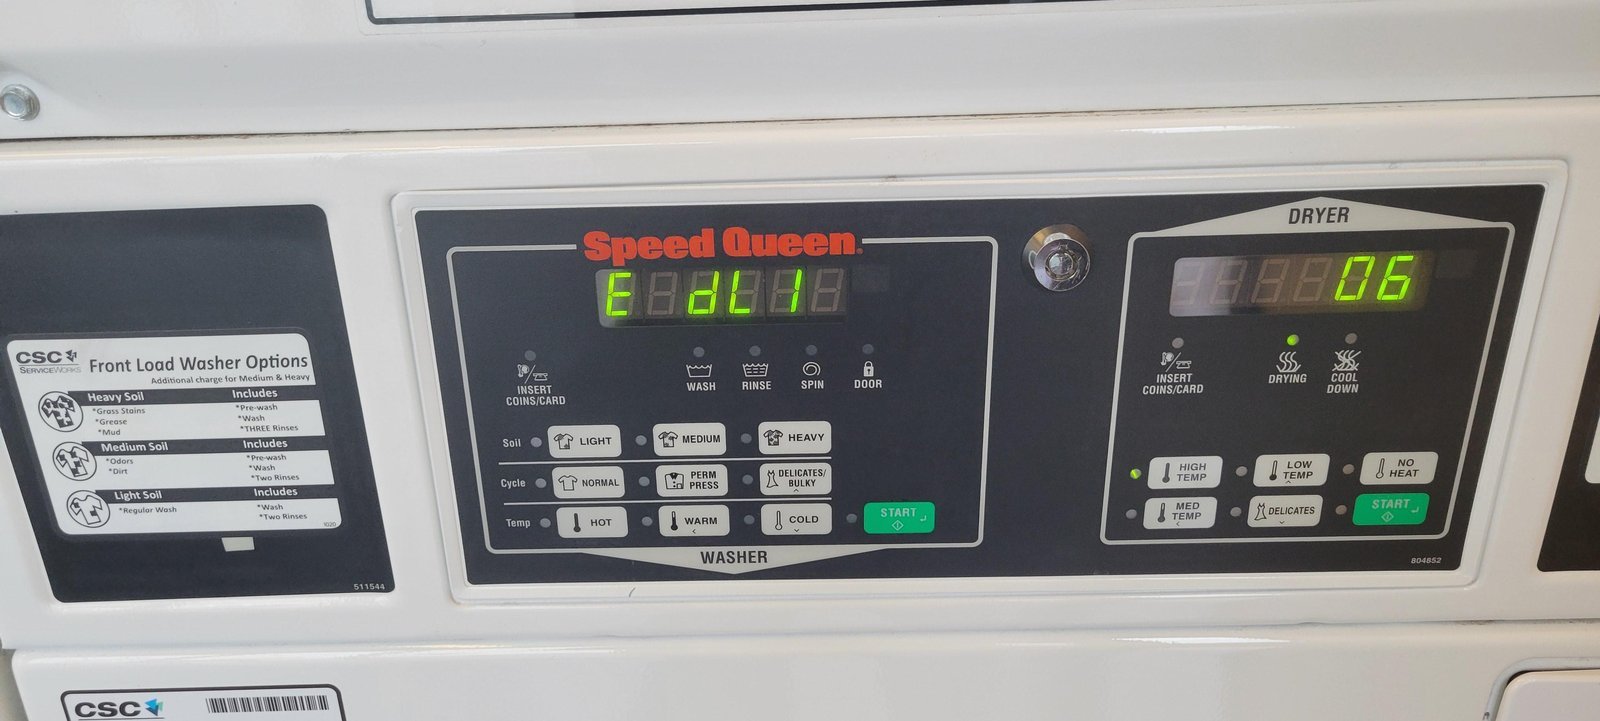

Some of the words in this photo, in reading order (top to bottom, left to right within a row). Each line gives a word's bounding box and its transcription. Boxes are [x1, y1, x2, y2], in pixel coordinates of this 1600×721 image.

[1288, 207, 1350, 225] DRYER
[584, 228, 715, 266] Speed
[723, 226, 856, 257] Queen
[1335, 256, 1414, 301] 06
[606, 272, 632, 317] E
[16, 352, 62, 364] CSC
[90, 358, 131, 372] Front
[137, 357, 175, 372] Load
[179, 356, 241, 370] Washer
[245, 354, 308, 370] Options
[151, 376, 193, 384] Additional
[196, 376, 222, 385] charge
[239, 374, 272, 382] Medium
[286, 373, 310, 382] Heavy
[1156, 373, 1193, 383] INSERT
[1268, 374, 1307, 383] DRYING
[1330, 373, 1358, 383] COOL
[686, 382, 716, 391] WASH
[741, 381, 772, 390] RINSE
[801, 380, 824, 390] SPIN
[854, 379, 882, 389] DOOR
[1142, 383, 1204, 395] COINS/CARD
[1326, 383, 1359, 393] DOWN
[232, 388, 278, 398] Includes
[517, 385, 552, 395] INSERT
[88, 392, 121, 404] Heavy
[124, 392, 145, 401] Soil
[505, 395, 566, 406] COINS/CARD
[273, 424, 299, 432] Rinses
[502, 437, 521, 448] Soil
[580, 435, 612, 446] LIGHT
[682, 434, 721, 444] MEDIUM
[788, 432, 825, 443] HEAVY
[101, 442, 146, 452] Medium
[148, 441, 168, 451] Soil
[243, 438, 288, 449] Includes
[1179, 462, 1207, 473] HIGH
[1287, 460, 1313, 470] LOW
[1398, 458, 1415, 468] NO
[275, 473, 299, 481] Rinses
[691, 470, 717, 480] PERM
[778, 468, 827, 478] DELICATES/
[1176, 473, 1207, 482] TEMP
[1283, 470, 1314, 480] TEMP
[1389, 468, 1420, 478] HEAT
[501, 477, 526, 490] Cycle
[581, 478, 619, 488] NORMAL
[689, 480, 719, 490] PRESS
[789, 478, 816, 488] BULKY
[114, 491, 141, 501] Light
[143, 489, 162, 499] Soil
[253, 486, 298, 497] Includes
[1176, 501, 1200, 511] MED
[1371, 499, 1411, 510] START
[880, 507, 917, 518] START
[1268, 505, 1315, 516] DELICATES
[282, 512, 308, 520] Rinses
[684, 516, 718, 526] WARM
[789, 515, 819, 525] COLD
[1172, 511, 1202, 521] TEMP
[505, 518, 531, 530] Temp
[590, 518, 612, 527] HOT
[700, 549, 768, 564] WASHER
[1410, 556, 1442, 564] 804852
[353, 583, 385, 591] 511544
[74, 700, 141, 718] CSC
